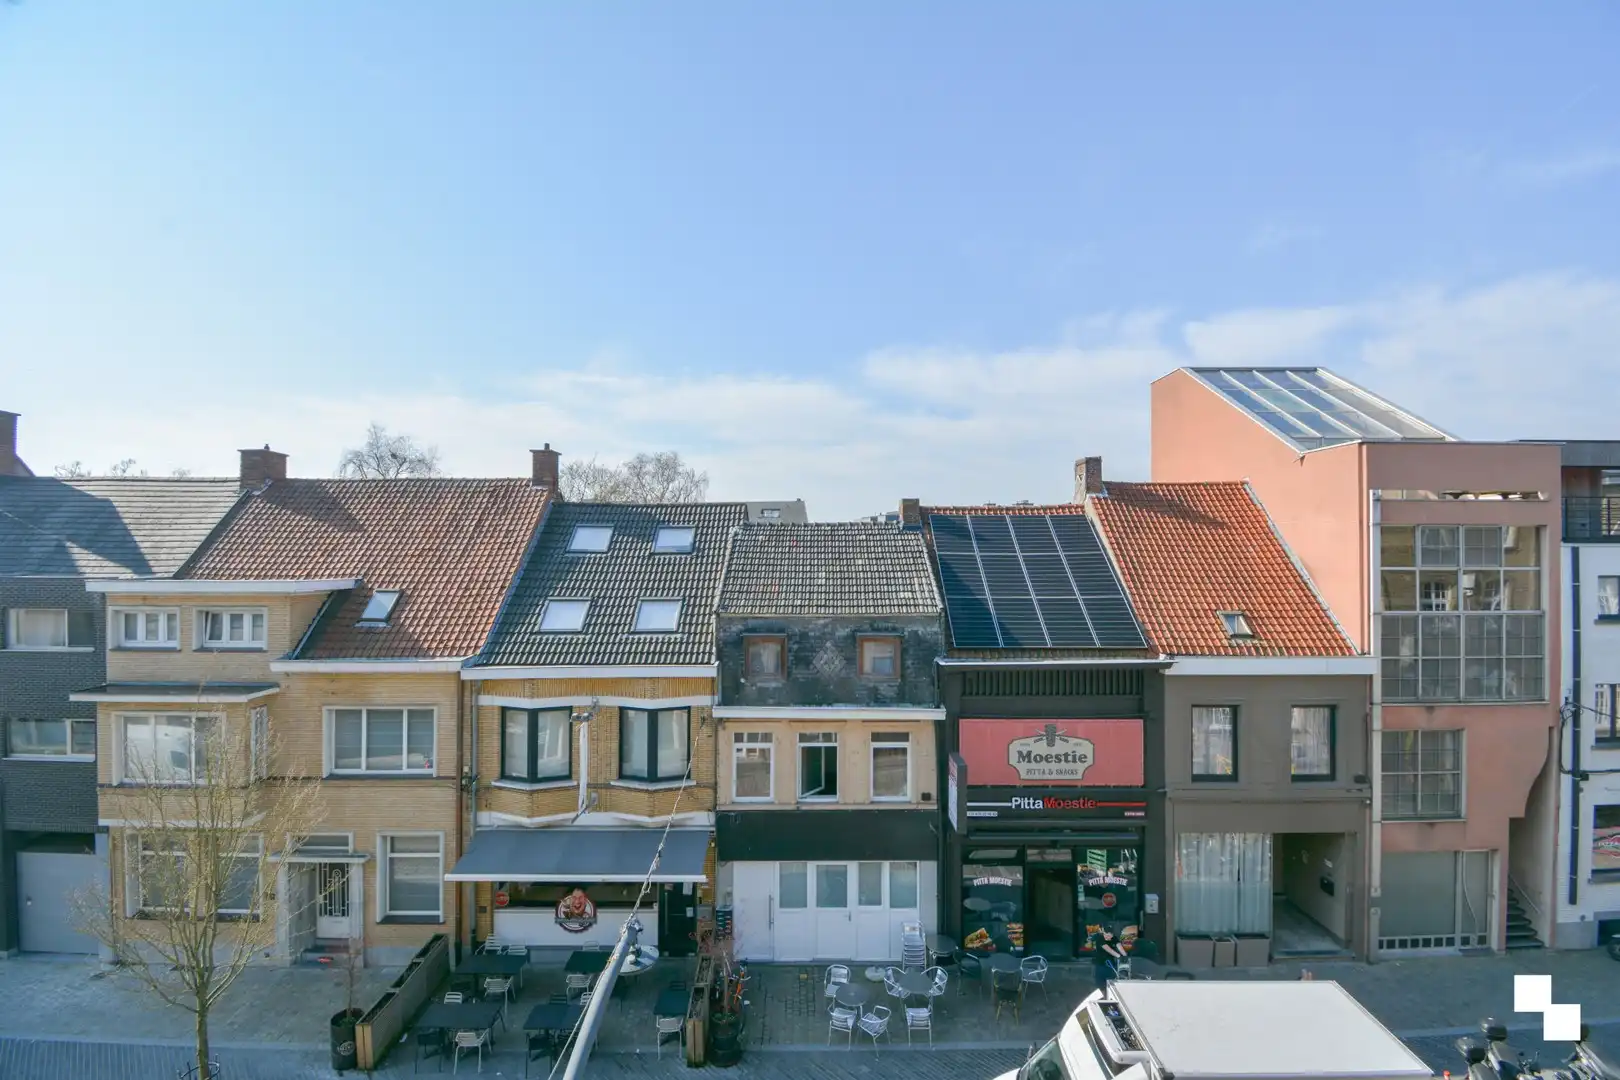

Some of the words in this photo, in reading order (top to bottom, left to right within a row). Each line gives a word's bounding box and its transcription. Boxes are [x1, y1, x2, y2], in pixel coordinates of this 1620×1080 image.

[1017, 750, 1088, 764] Moestie
[973, 877, 988, 886] PITTA
[990, 876, 1012, 886] MOESTIE
[1088, 877, 1103, 886] PITTA
[1105, 876, 1128, 886] MOESTIE
